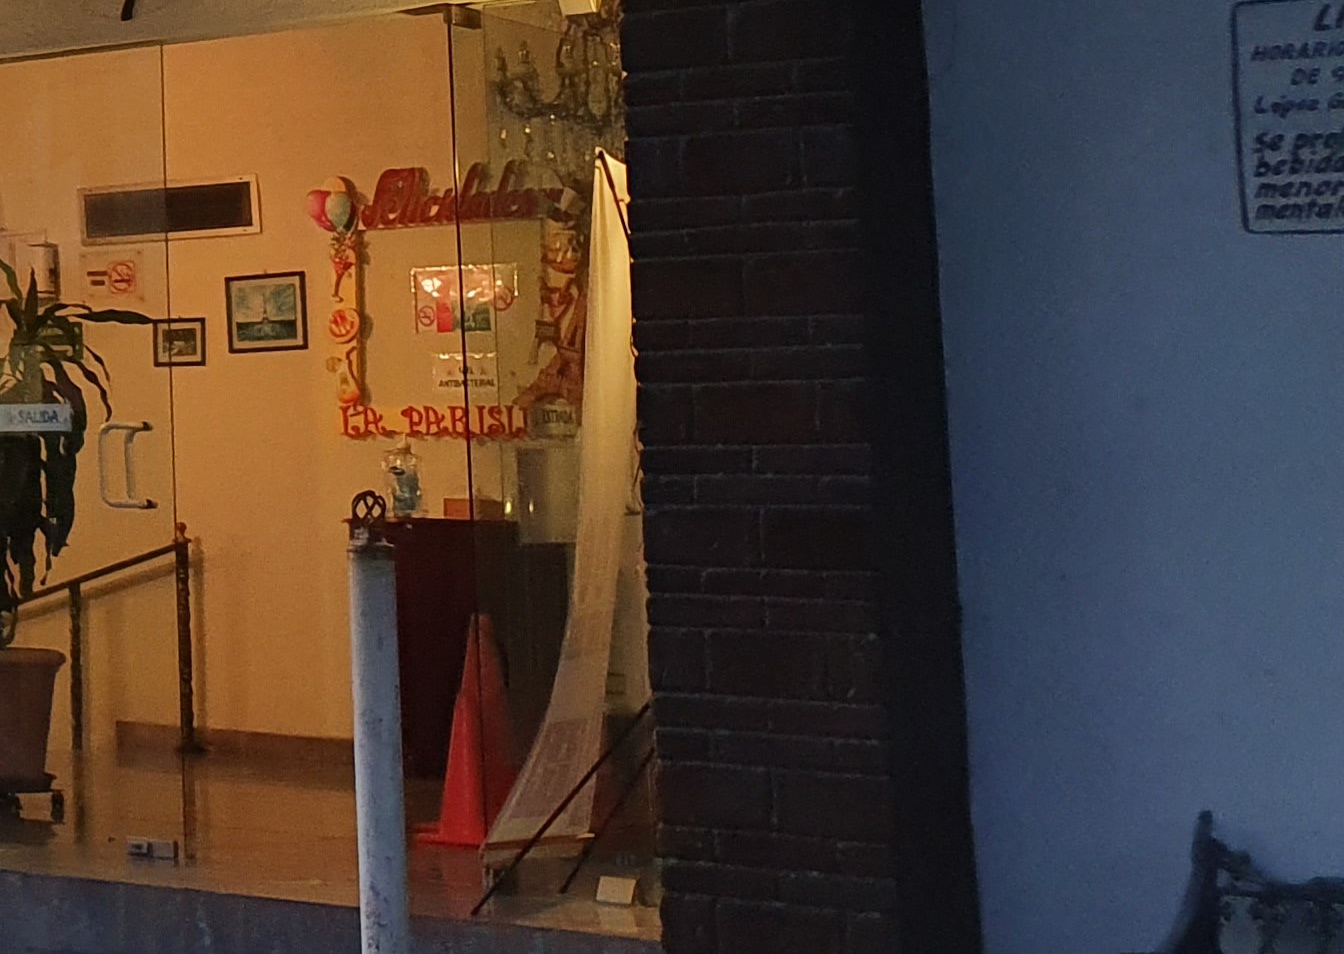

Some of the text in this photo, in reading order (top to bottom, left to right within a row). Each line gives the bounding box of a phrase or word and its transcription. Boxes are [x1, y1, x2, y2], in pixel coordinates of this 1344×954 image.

[1290, 67, 1320, 85] DE
[1255, 129, 1344, 155] Se pro
[438, 378, 496, 388] ANTIBTERIAL
[17, 409, 59, 424] SALIDA
[339, 405, 387, 435] LA
